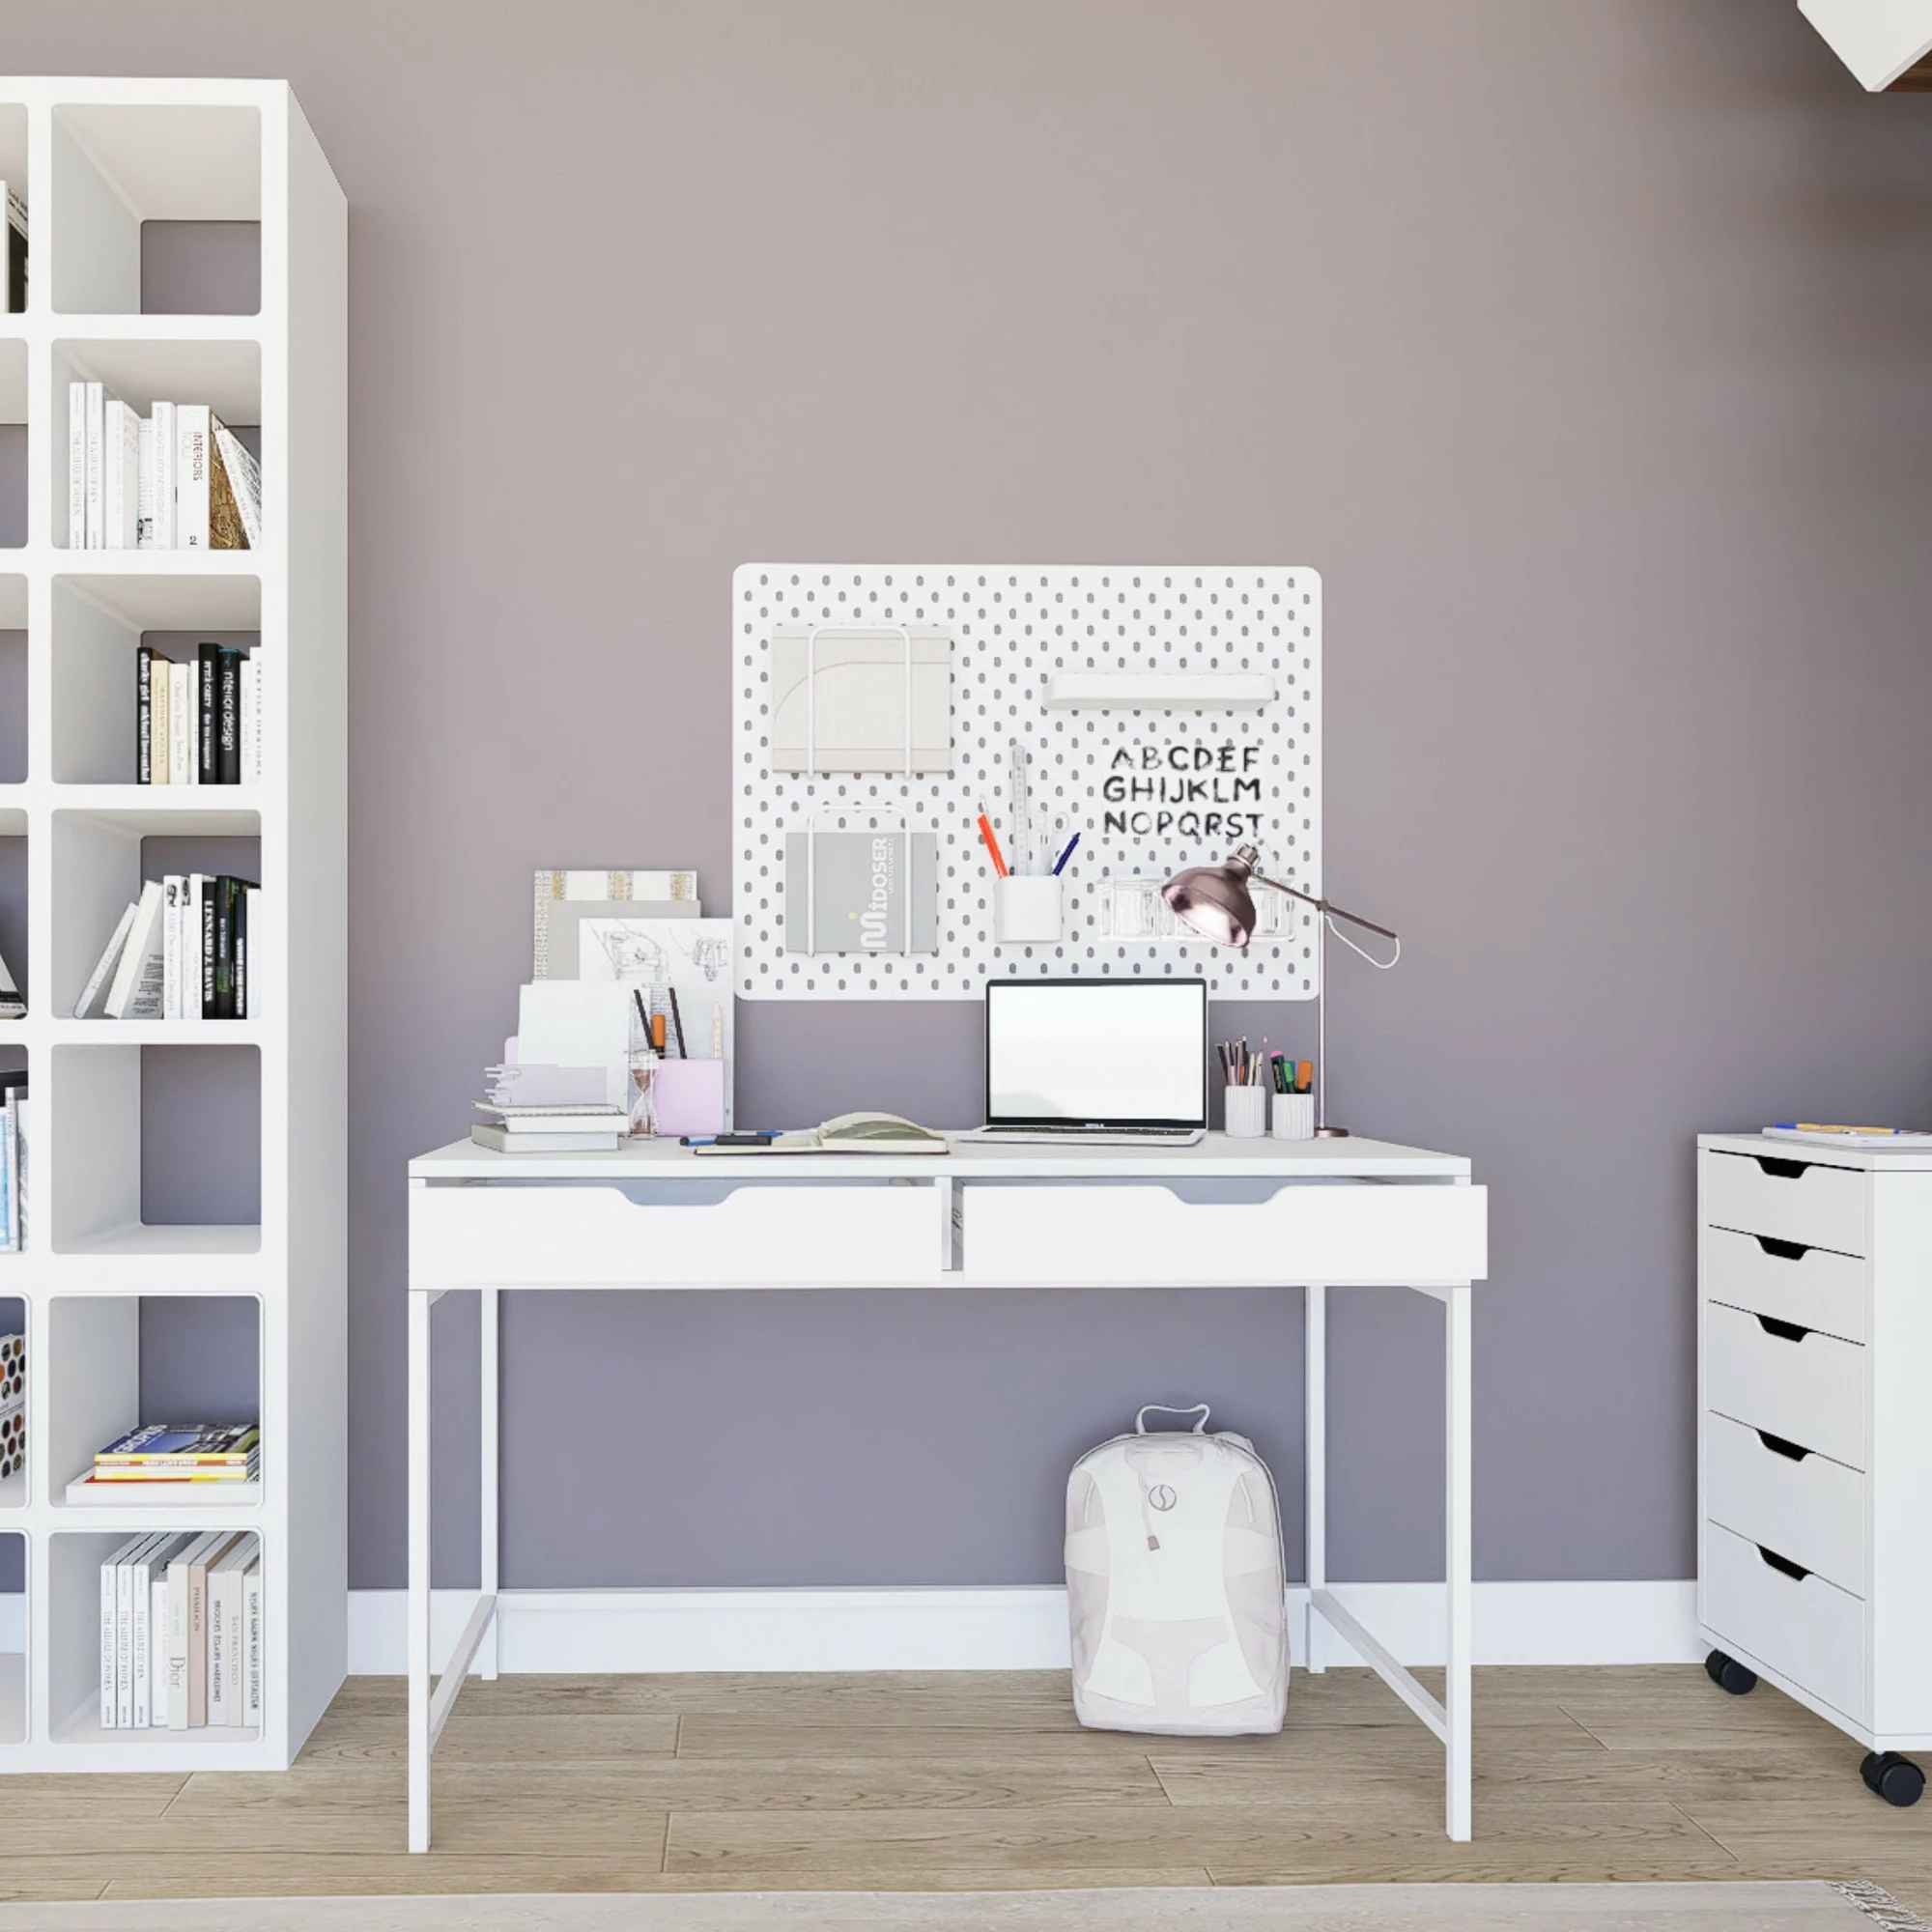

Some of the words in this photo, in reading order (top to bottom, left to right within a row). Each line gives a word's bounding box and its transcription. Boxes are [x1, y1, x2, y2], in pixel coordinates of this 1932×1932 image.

[193, 431, 203, 481] INTERIORS
[188, 535, 199, 547] 2
[221, 711, 236, 751] design
[1110, 746, 1261, 773] ABCDEF
[1103, 776, 1261, 804] GHIJKLM
[1104, 810, 1264, 838] NOPQRST
[204, 967, 213, 1002] DAVIS
[231, 1615, 240, 1634] SAN
[169, 1656, 185, 1689] Dior
[231, 1635, 240, 1686] FRANCISCO
